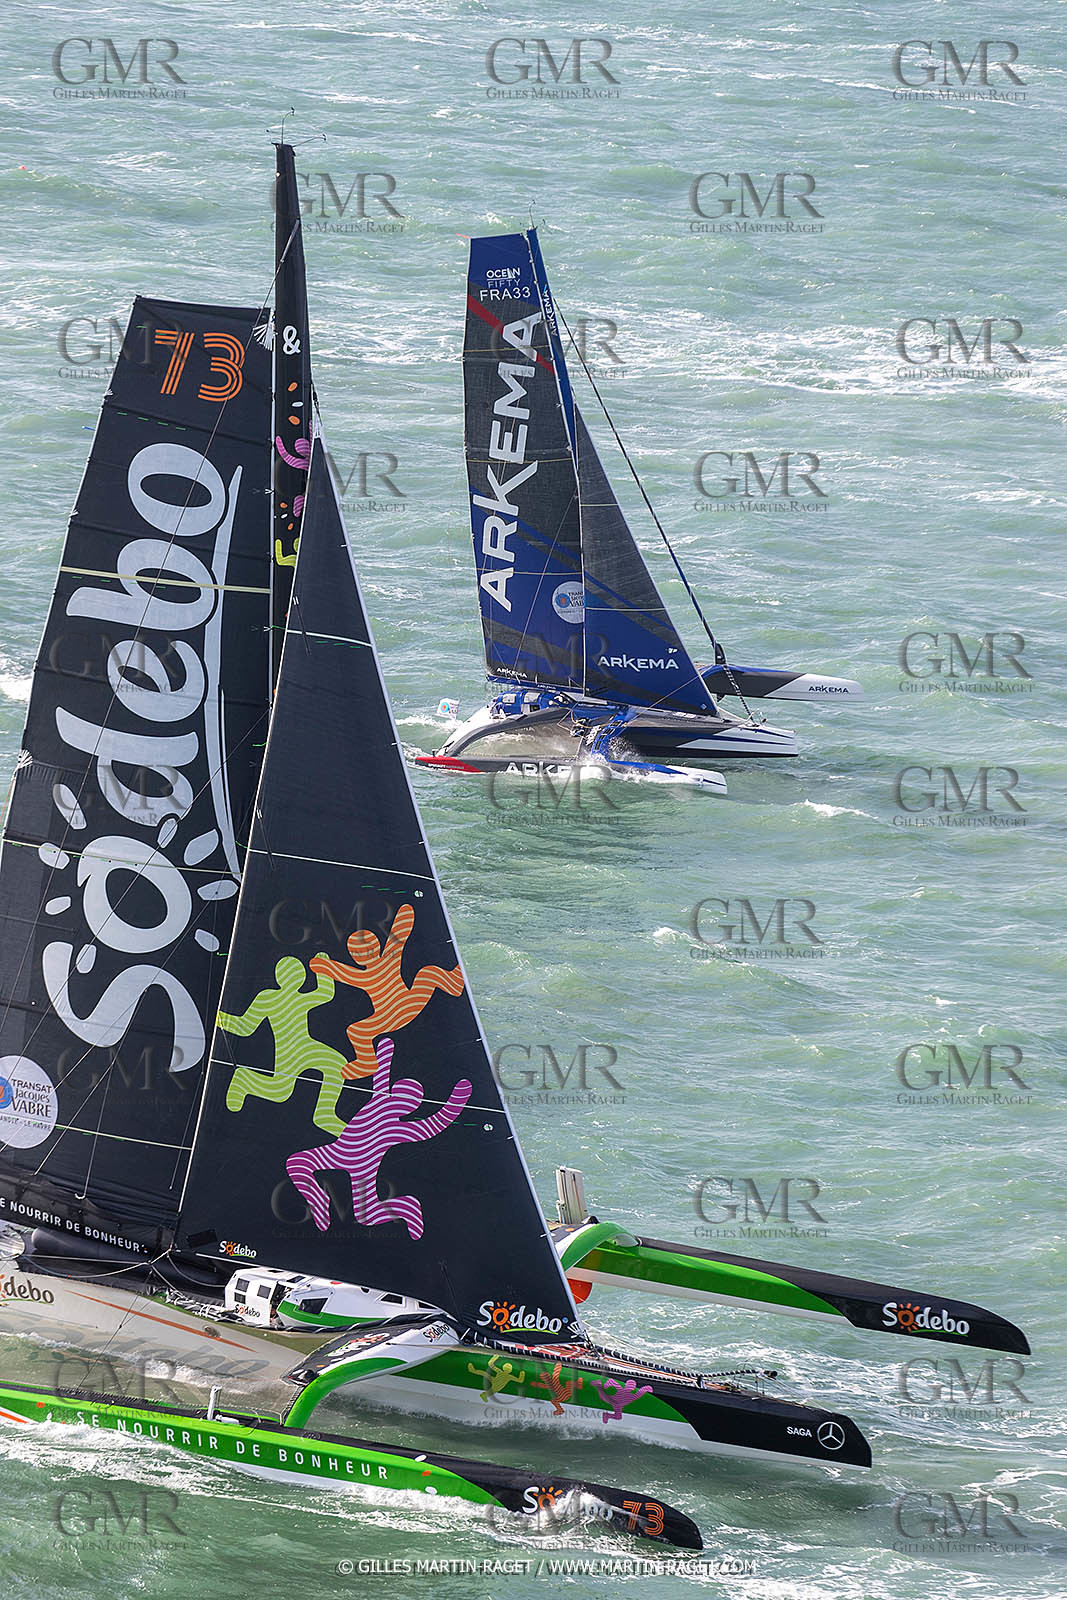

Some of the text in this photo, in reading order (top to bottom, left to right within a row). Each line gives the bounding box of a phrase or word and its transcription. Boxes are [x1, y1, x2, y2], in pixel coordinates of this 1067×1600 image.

[480, 286, 531, 302] FRA33
[487, 278, 521, 289] FIFTY
[541, 288, 559, 337] ARKEMA
[154, 329, 245, 402] 73
[472, 311, 543, 614] ARKEMA
[496, 667, 528, 679] ARKEMA
[597, 654, 679, 672] ARKEMA
[808, 684, 850, 694] ARKEMA
[42, 442, 228, 1075] Sodebo
[11, 1078, 52, 1094] TRANSAT
[11, 1096, 52, 1118] VABRE
[10, 1200, 62, 1227] NOURRIR
[66, 1219, 81, 1233] DE
[85, 1226, 141, 1254] BONHEUR
[219, 1240, 257, 1258] Sodebo
[234, 1304, 261, 1318] Sodebo
[477, 1300, 562, 1333] Sodebo
[882, 1302, 970, 1336] Sodebo
[422, 1323, 450, 1343] Sodebo
[786, 1426, 812, 1438] SAGA
[77, 1411, 100, 1428] SE
[117, 1418, 219, 1450] NOURRIR
[236, 1440, 261, 1457] DE
[278, 1448, 388, 1480] BONHEUR
[622, 1500, 665, 1536] 73
